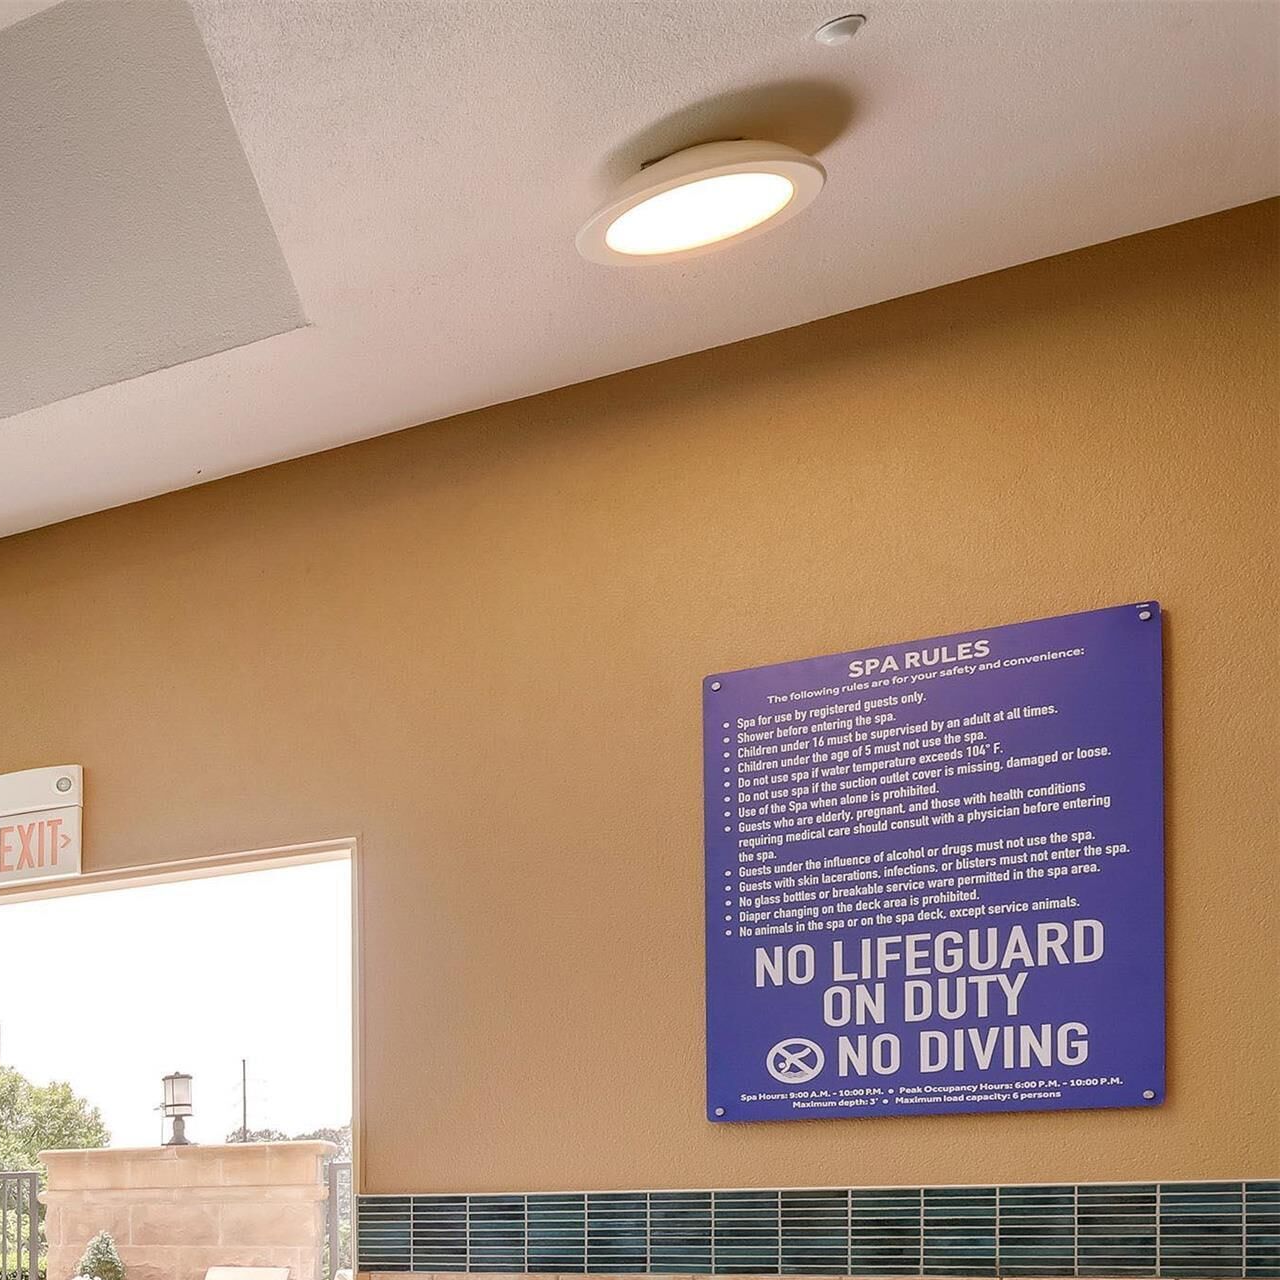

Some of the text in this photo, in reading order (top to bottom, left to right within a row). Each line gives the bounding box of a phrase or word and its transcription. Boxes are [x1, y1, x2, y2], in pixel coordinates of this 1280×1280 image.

[766, 647, 1084, 703] The following rules are for your safety and convenience:
[848, 639, 989, 677] SPA RULES
[736, 690, 926, 730] Spa for use by registered guests only.
[736, 712, 896, 743] Shower before entering the spa.
[737, 705, 1058, 758] Children under 16 must be supervised by an adult at all times.
[737, 731, 987, 773] Children under the age of 5 must not use the spa.
[737, 742, 1003, 788] Do not use spa if water temperature exceeds 104° F.
[738, 782, 939, 818] Use of the Spa when alone is prohibited.
[0, 819, 62, 873] EXIT
[738, 831, 1095, 877] Guests under the influence of alcohol or drugs must not use the spa.
[739, 863, 1100, 908] No glass bottles or breakable service ware permitted in the spa area.
[739, 888, 979, 923] Diaper changing on the deck area is prohibited.
[755, 919, 1103, 987] NO LIFEGUARD
[823, 972, 1028, 1027] ON DUTY
[838, 1021, 1088, 1077] NO DIVING
[895, 1091, 1061, 1104] Maximum load capacity: 6 persons
[899, 1085, 922, 1094] Peak
[923, 1084, 978, 1093] Occupancy
[1014, 1080, 1037, 1089] 6:00
[1038, 1079, 1060, 1087] P.M.
[1069, 1078, 1098, 1086] 10:00
[1099, 1076, 1123, 1085] P.M.
